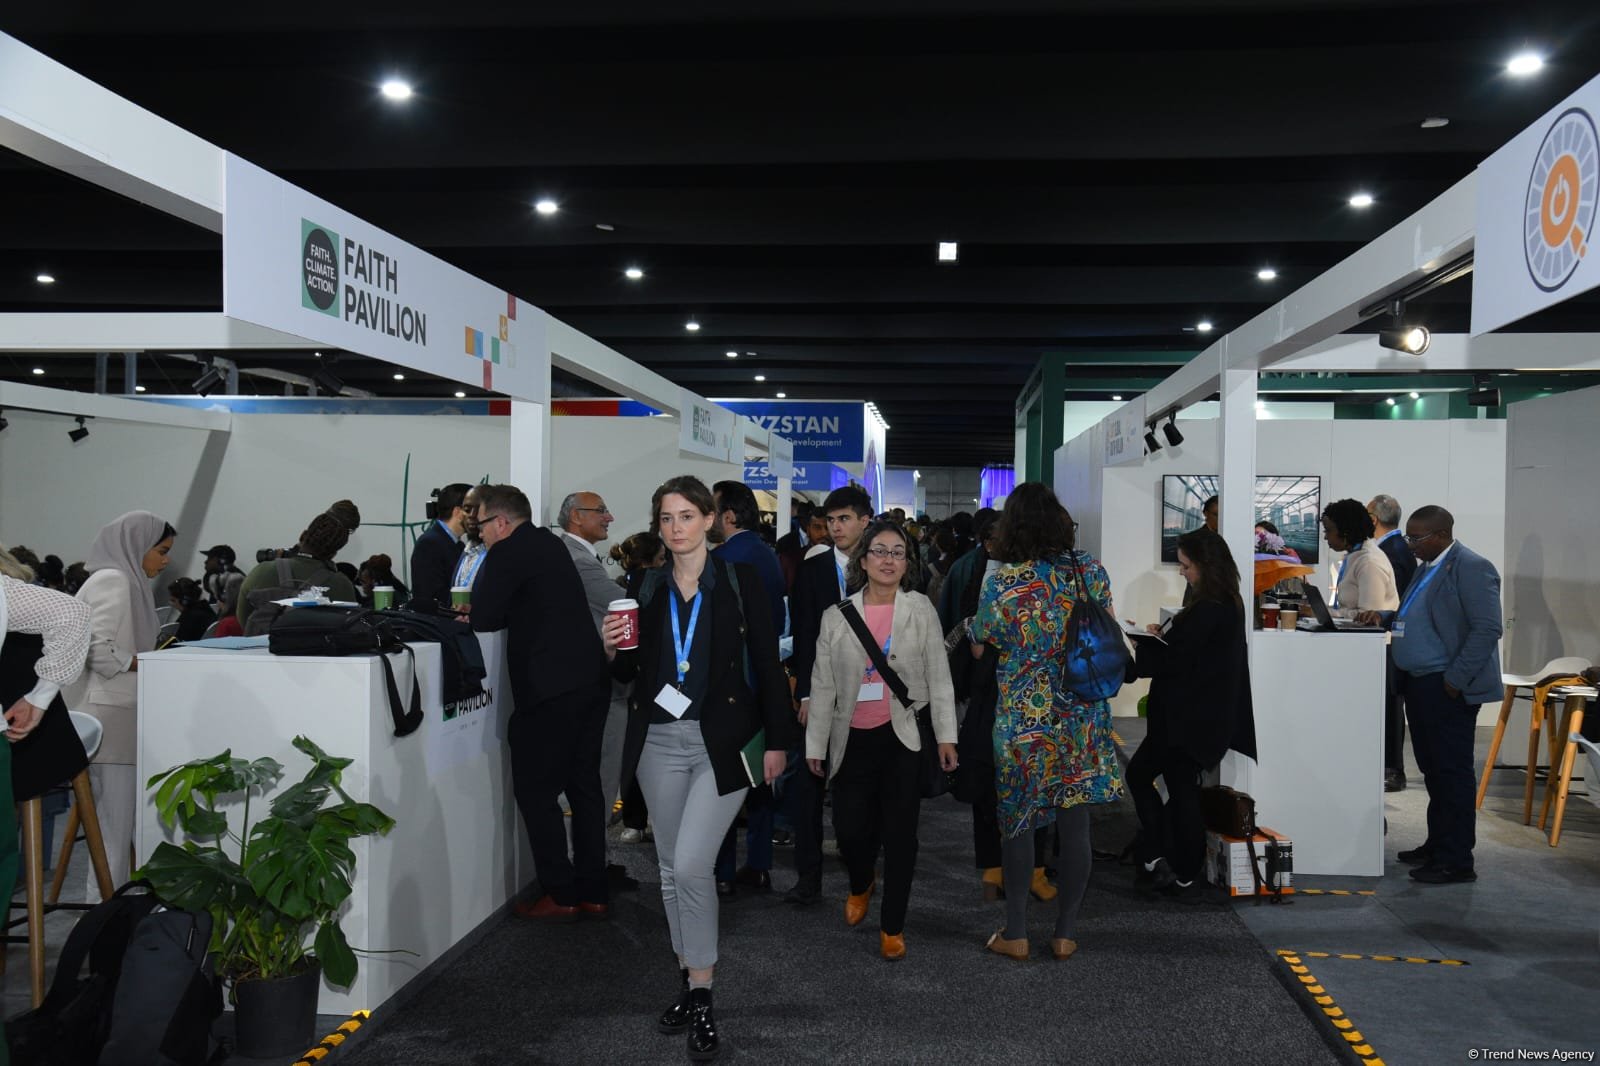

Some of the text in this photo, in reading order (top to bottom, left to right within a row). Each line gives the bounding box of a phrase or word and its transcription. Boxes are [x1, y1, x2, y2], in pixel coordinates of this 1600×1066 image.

[310, 243, 332, 263] FAITH.
[305, 257, 336, 280] CLIMATE.
[345, 237, 397, 294] FAITH
[307, 274, 335, 295] ACTION.
[345, 283, 426, 346] PAVILION
[746, 415, 839, 434] YZSTAN
